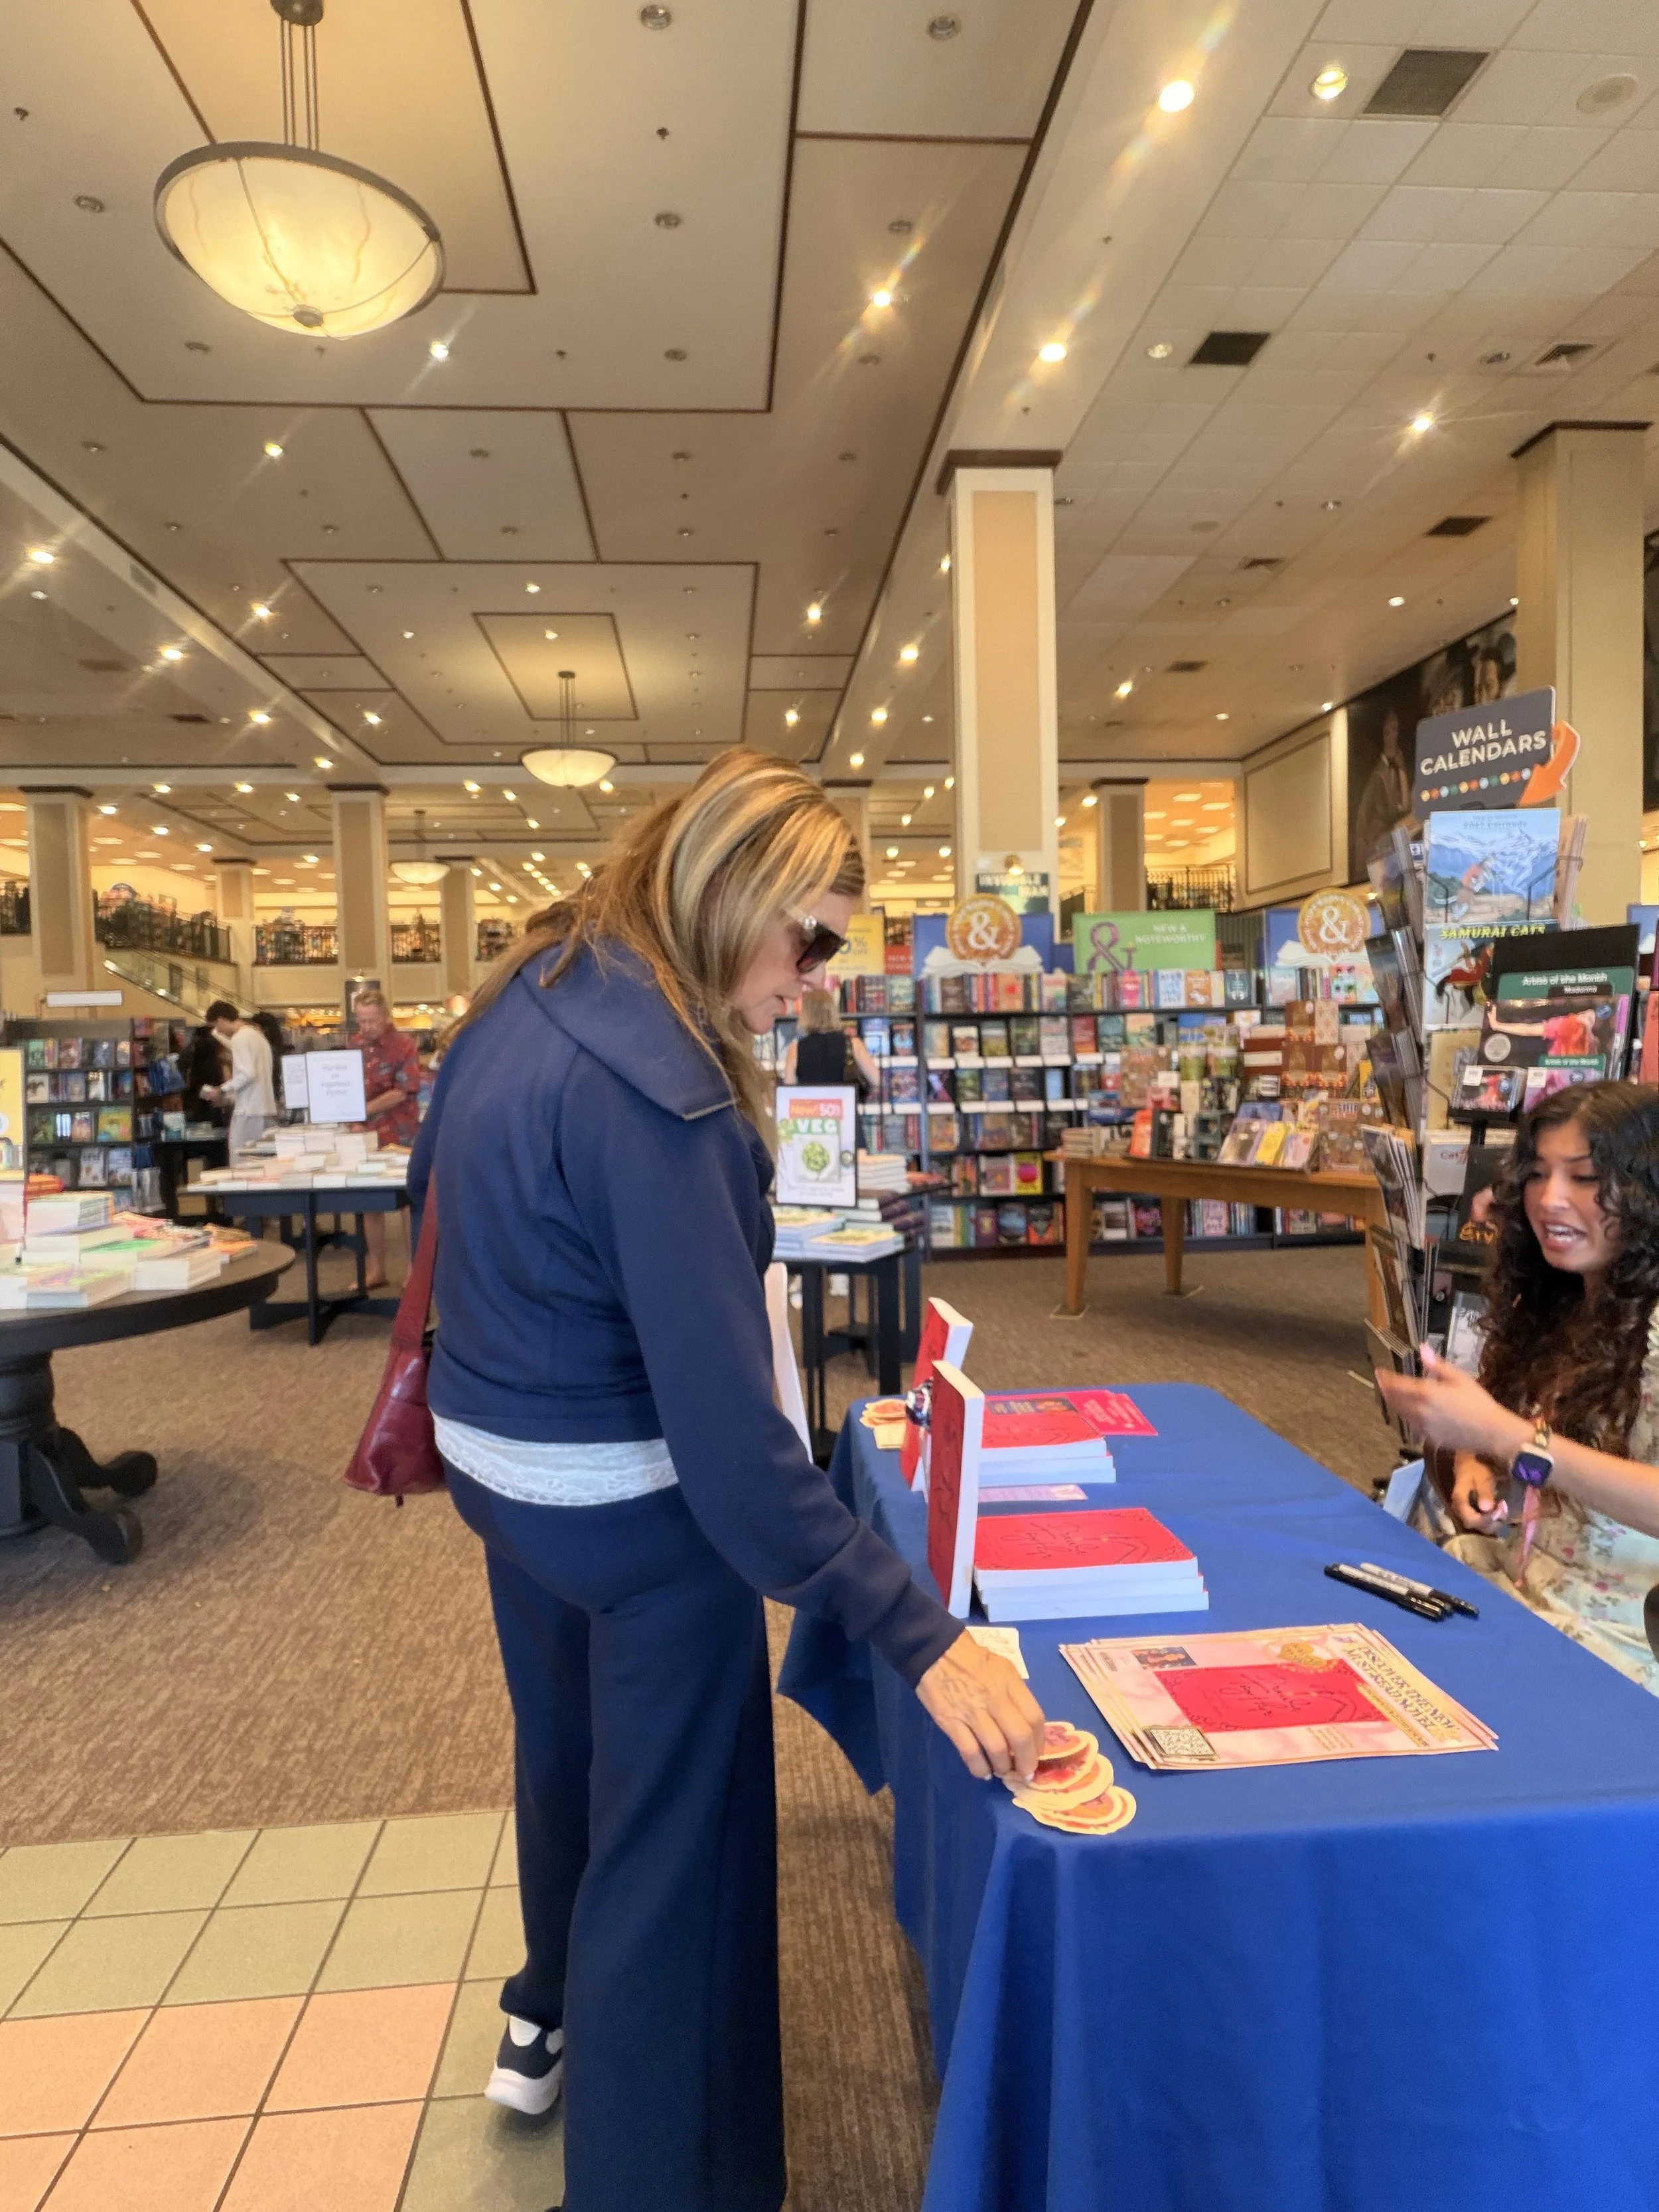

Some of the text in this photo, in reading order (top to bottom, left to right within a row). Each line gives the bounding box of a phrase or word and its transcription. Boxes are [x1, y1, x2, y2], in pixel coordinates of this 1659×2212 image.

[1451, 719, 1512, 748] WALL
[1419, 730, 1547, 776] CALENDARS
[1153, 923, 1177, 933] NEW
[1440, 925, 1507, 940] SAMURAI
[1135, 933, 1206, 944] NOTEWORTHY
[1522, 972, 1608, 986] Artist of the Month
[1563, 985, 1598, 994] Madonna
[796, 1118, 837, 1134] VEG
